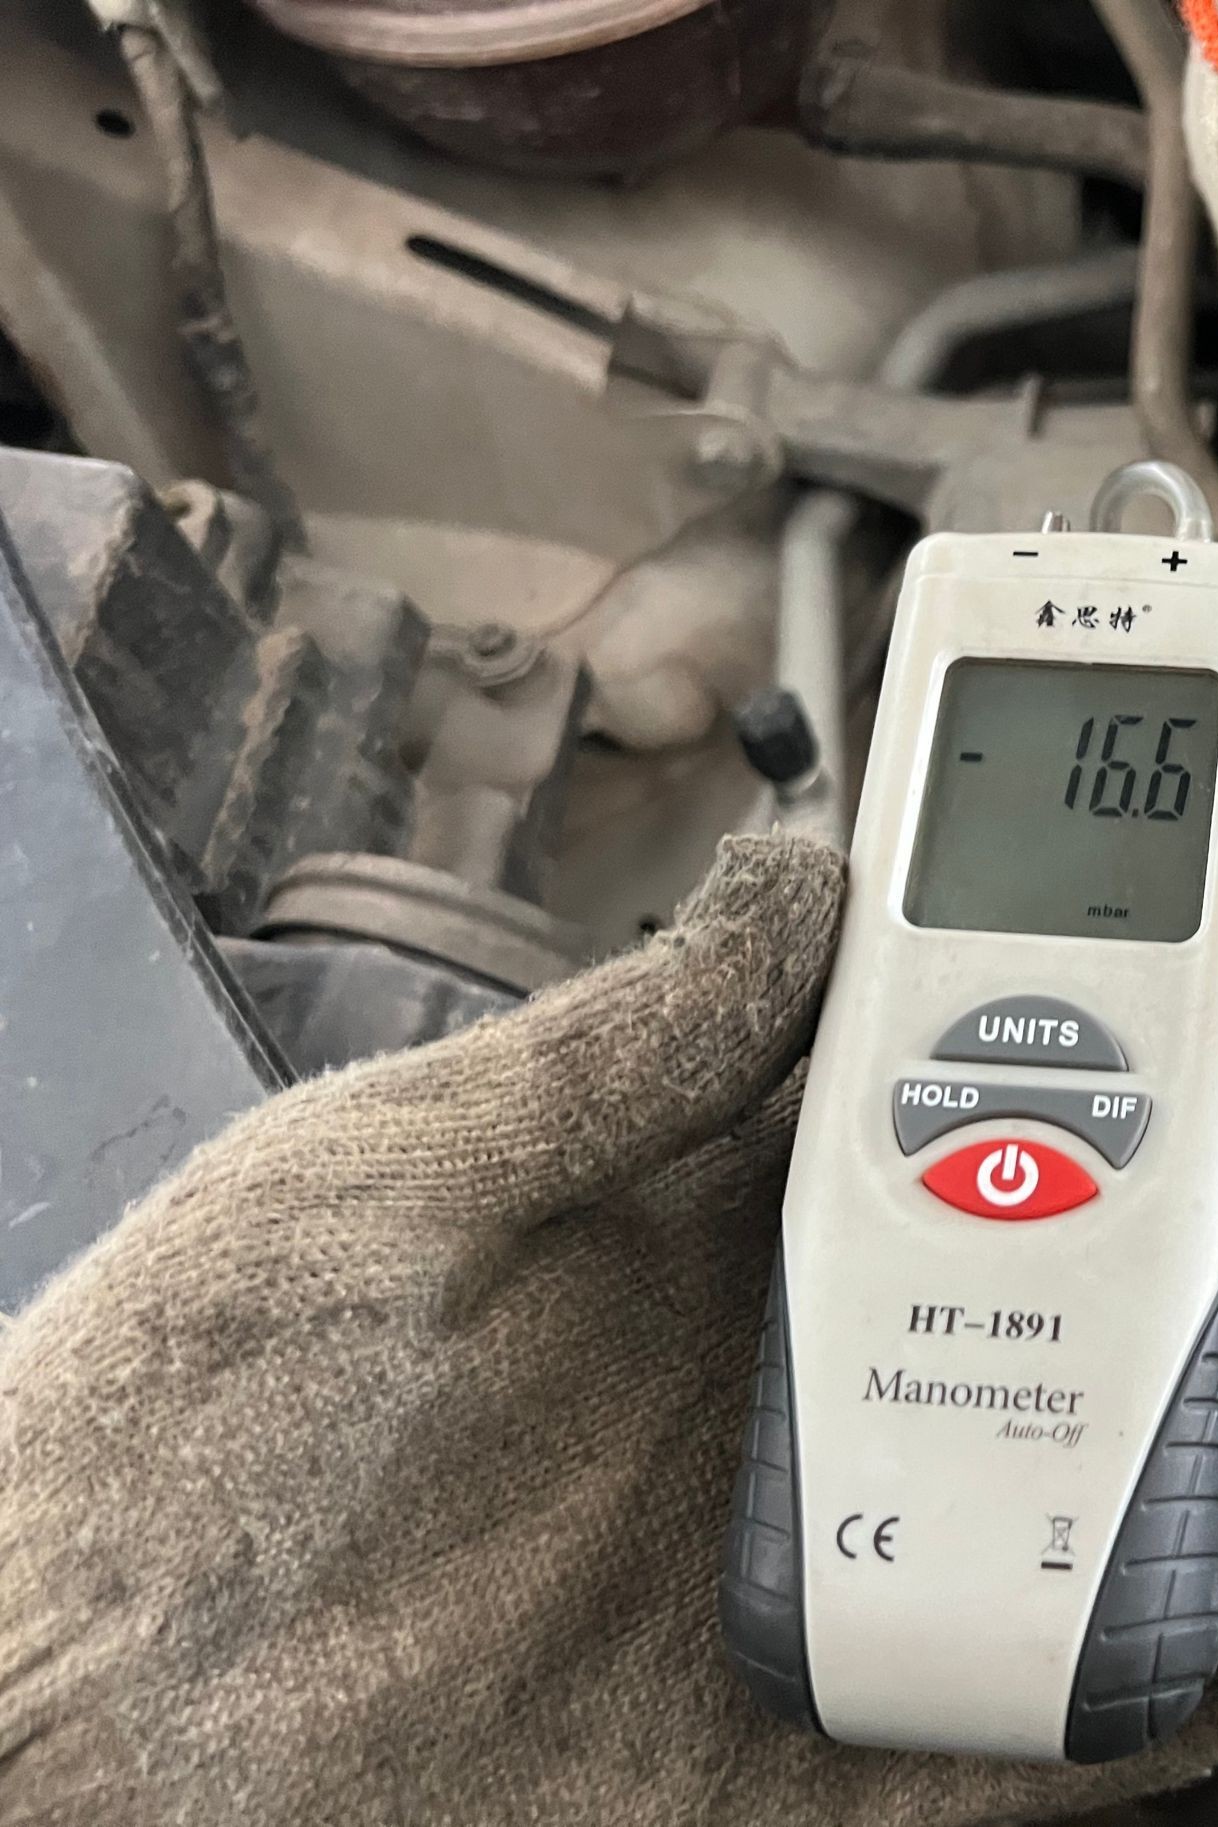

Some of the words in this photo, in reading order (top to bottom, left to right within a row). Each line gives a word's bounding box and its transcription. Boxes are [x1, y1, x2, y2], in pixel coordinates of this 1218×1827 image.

[1087, 903, 1130, 918] mbar
[978, 1015, 1080, 1047] UNITS
[901, 1083, 980, 1109] HOLD
[1091, 1095, 1138, 1119] DIF
[907, 1303, 1064, 1343] HT-1891
[861, 1366, 1085, 1415] Manometer
[996, 1418, 1088, 1449] Auto-Off
